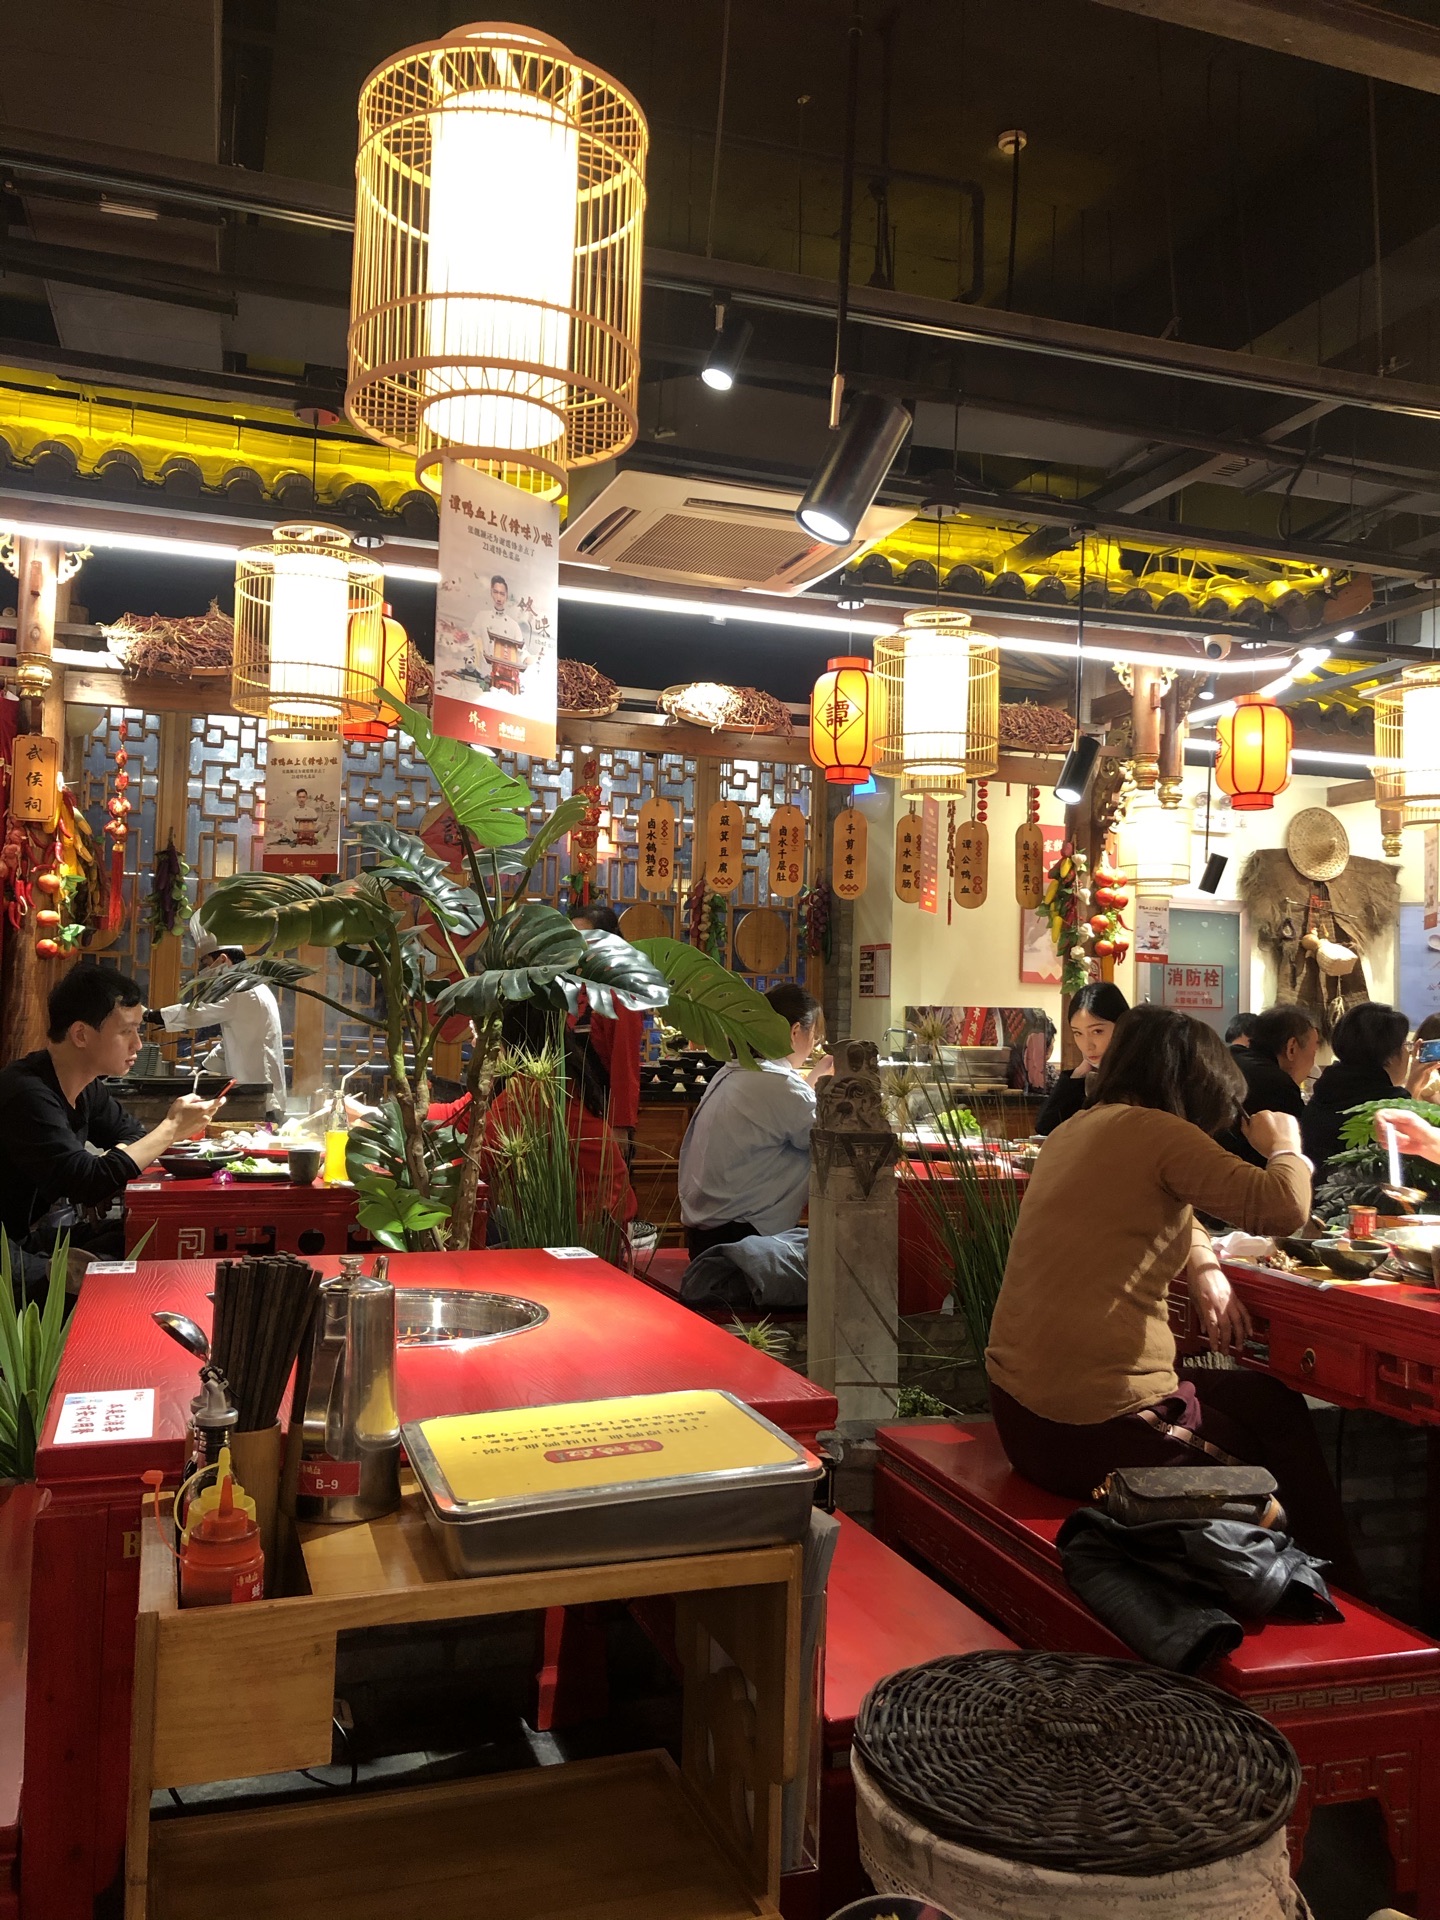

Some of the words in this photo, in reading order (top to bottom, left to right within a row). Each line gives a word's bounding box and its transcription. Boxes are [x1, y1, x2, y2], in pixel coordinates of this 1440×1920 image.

[449, 494, 553, 548] 谭鸭血上《锋味》啦
[825, 700, 849, 728] 譚
[24, 743, 44, 813] 武侯祠
[645, 817, 657, 877] 卤水鹌鹑蛋
[776, 825, 788, 882] 卤水千层肚
[843, 823, 856, 880] 手剪香菇
[902, 832, 912, 889] 卤水肥肠
[960, 839, 972, 894] 谭公鸭血
[1022, 841, 1031, 896] 卤水豆腐干
[1167, 967, 1220, 987] 消防栓
[315, 1478, 339, 1490] B-9
